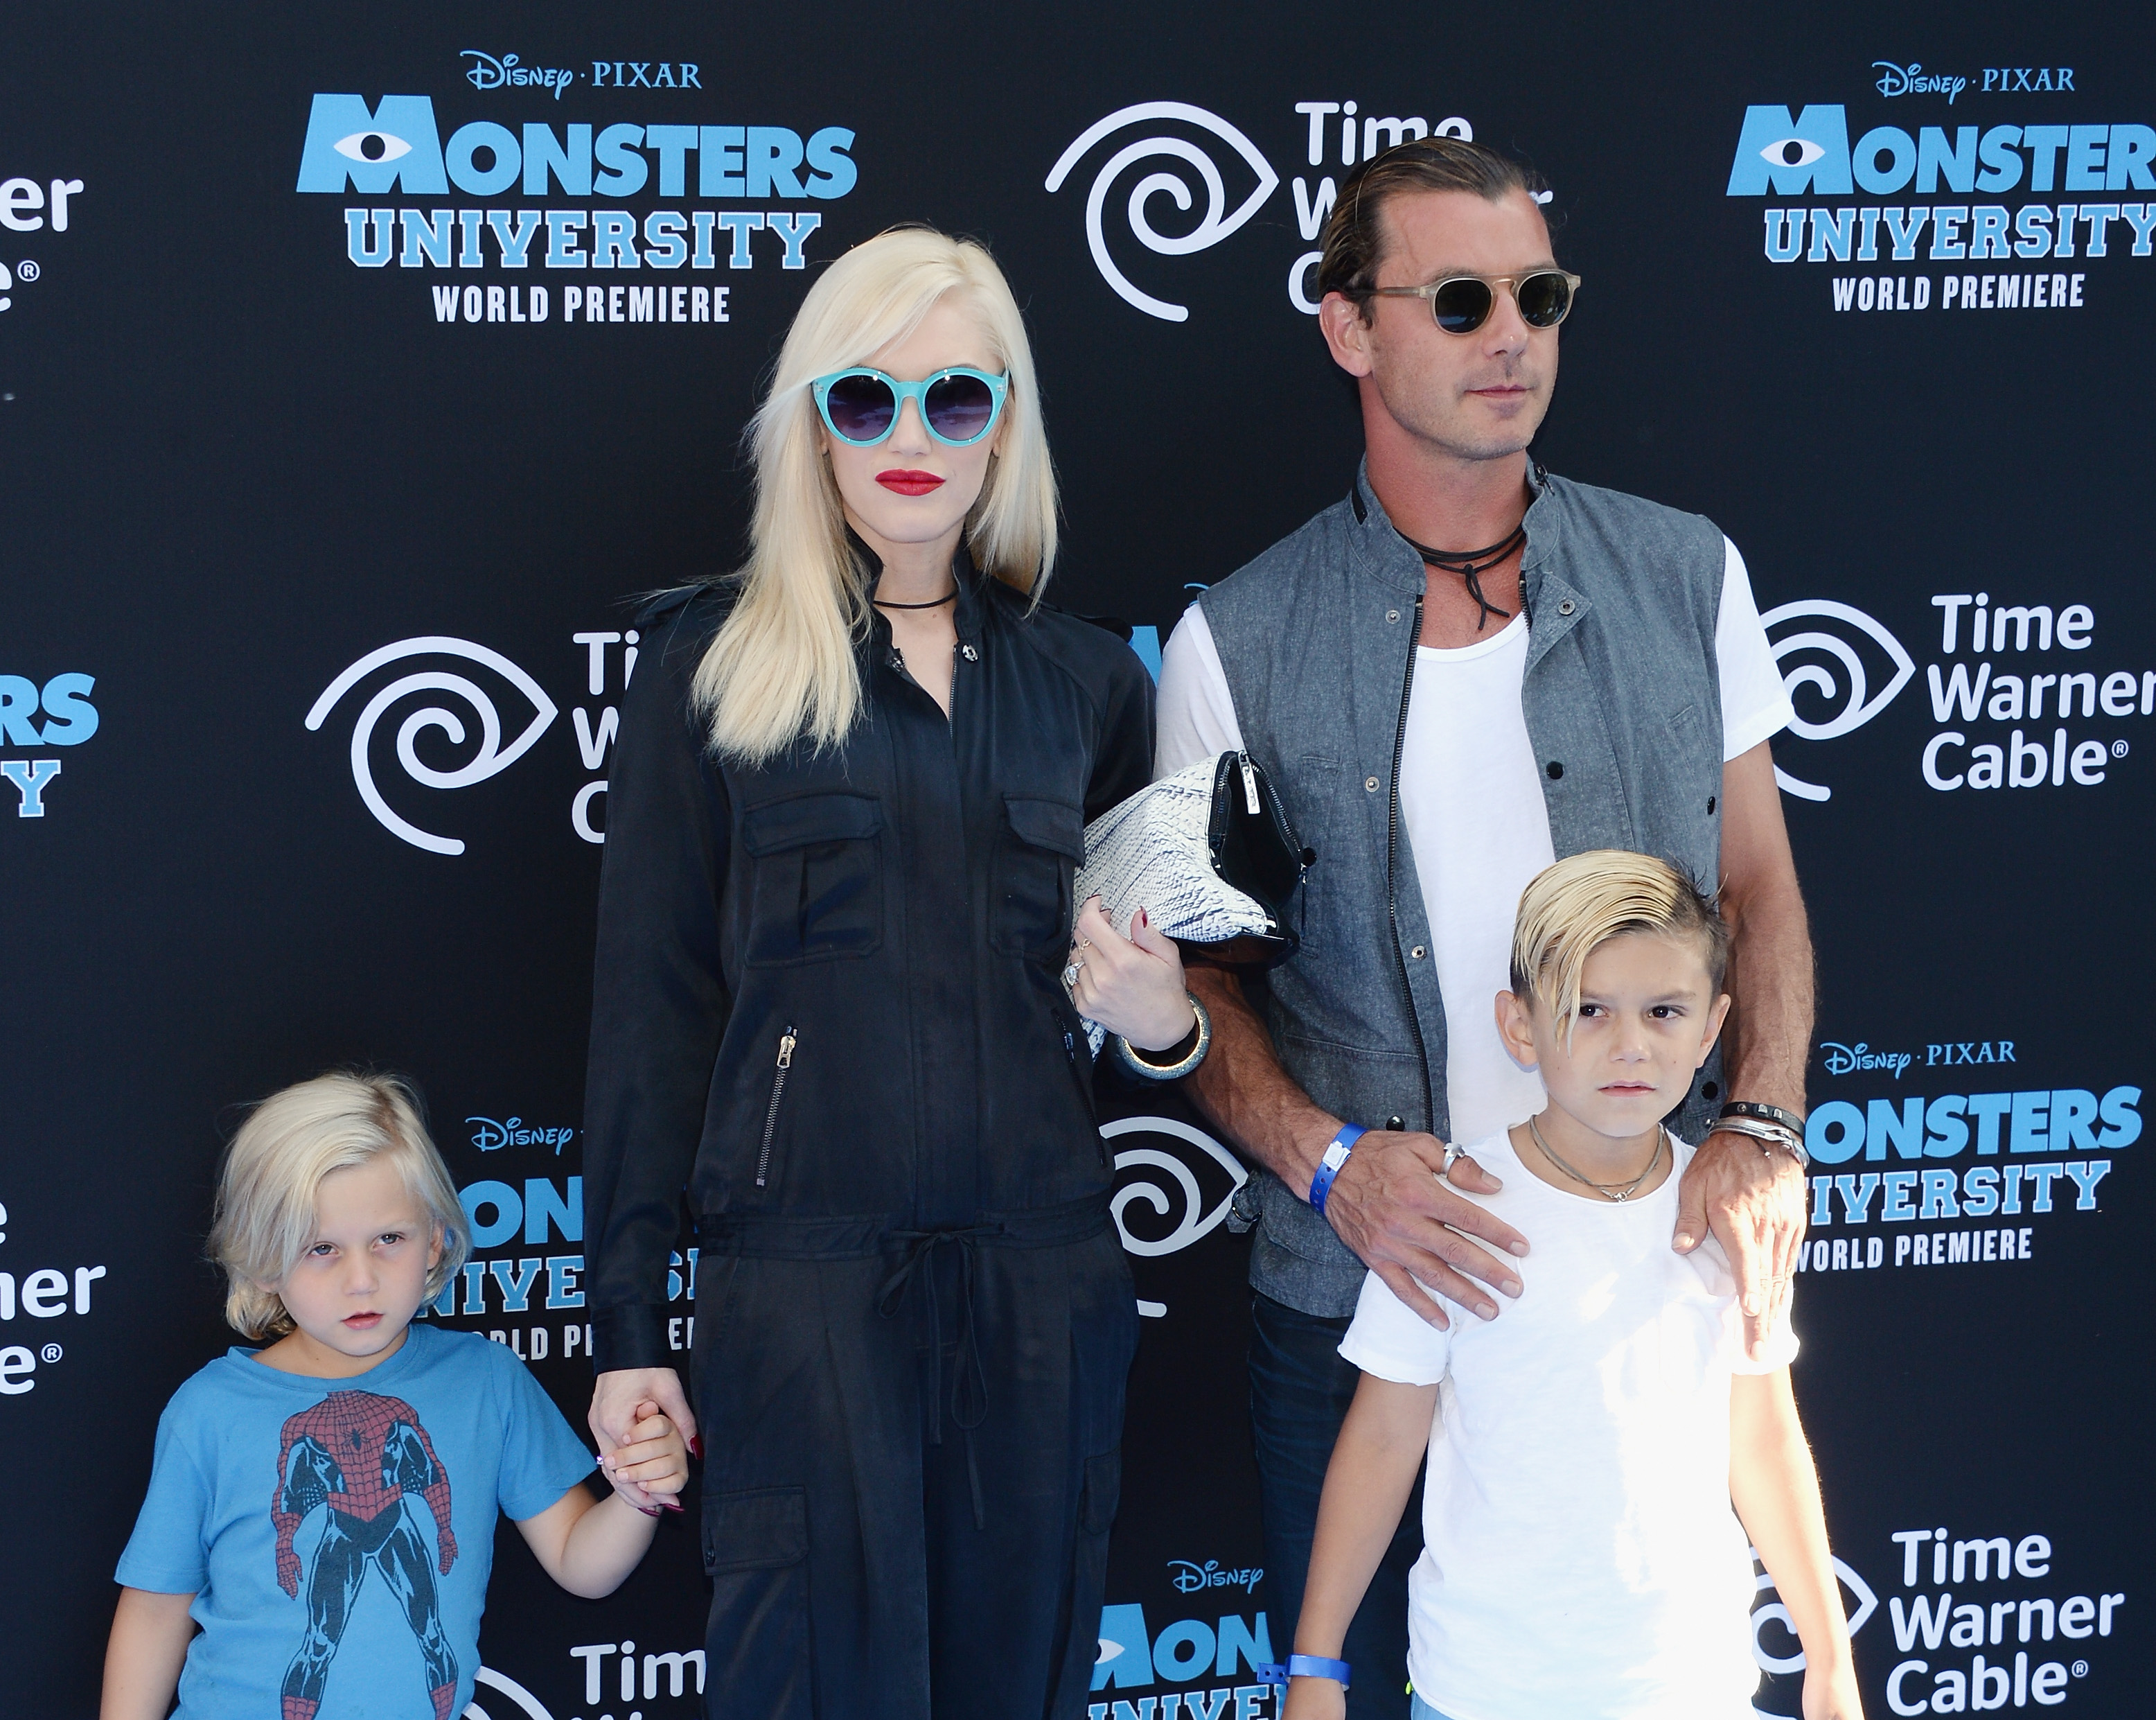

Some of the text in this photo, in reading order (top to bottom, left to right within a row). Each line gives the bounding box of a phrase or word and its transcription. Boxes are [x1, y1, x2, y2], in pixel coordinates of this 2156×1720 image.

[592, 62, 702, 89] PIXAR
[1981, 68, 2075, 92] PIXAR
[296, 93, 857, 200] MONSTERS
[1726, 104, 2156, 196] MONSTER
[344, 209, 821, 270] UNIVERSITY
[1764, 204, 2156, 263] UNIVERSITY
[432, 285, 730, 322] WORLD PREMIERE
[1832, 273, 2085, 311] WORLD PREMIERE
[1932, 592, 2094, 653] Time
[1927, 662, 2156, 722] Warner
[1926, 1041, 2016, 1066] PIXAR
[1805, 1160, 2111, 1226] IVERSITY
[1895, 1227, 2033, 1266] PREMIERE
[1891, 1527, 2052, 1587] Time
[1889, 1593, 2126, 1653] Warner
